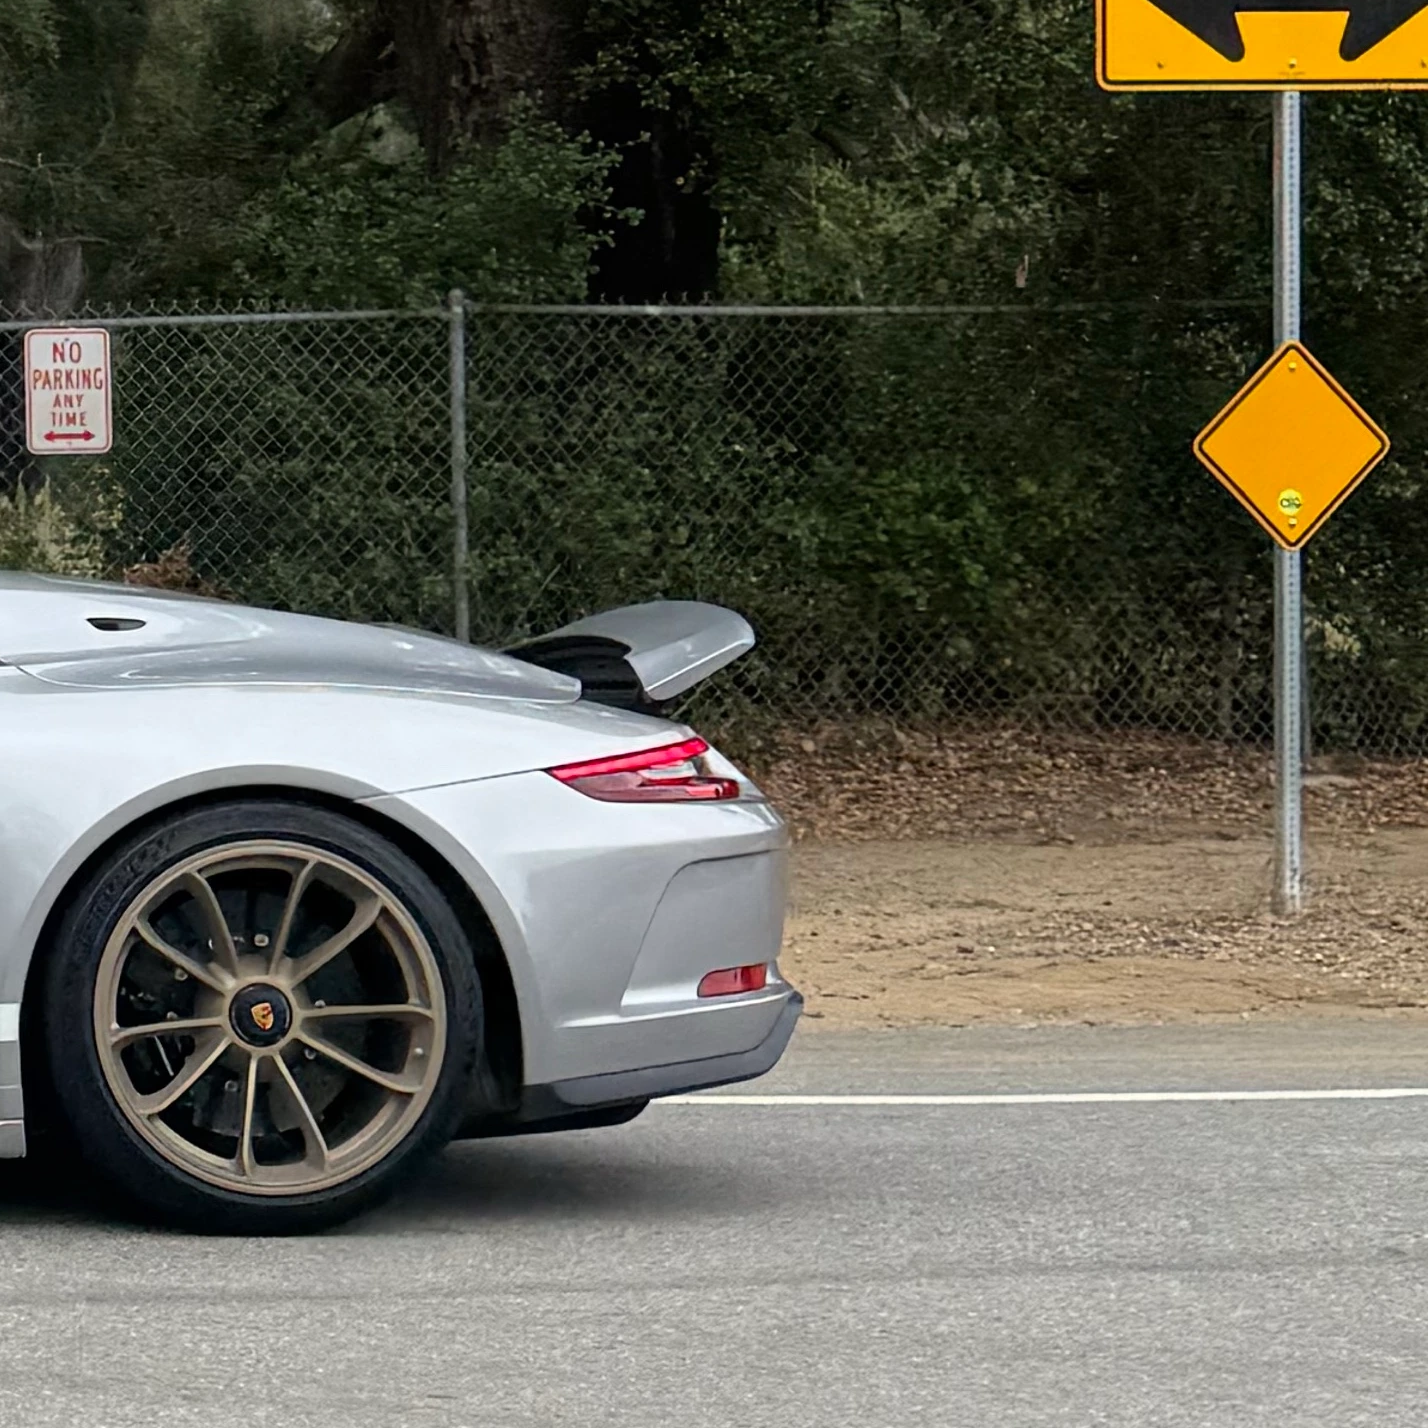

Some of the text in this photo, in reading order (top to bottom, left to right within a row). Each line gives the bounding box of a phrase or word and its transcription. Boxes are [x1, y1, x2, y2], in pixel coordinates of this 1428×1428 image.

[52, 341, 82, 364] NO
[32, 368, 103, 390] PARKING
[53, 394, 84, 408] ANY
[51, 412, 87, 427] TIME
